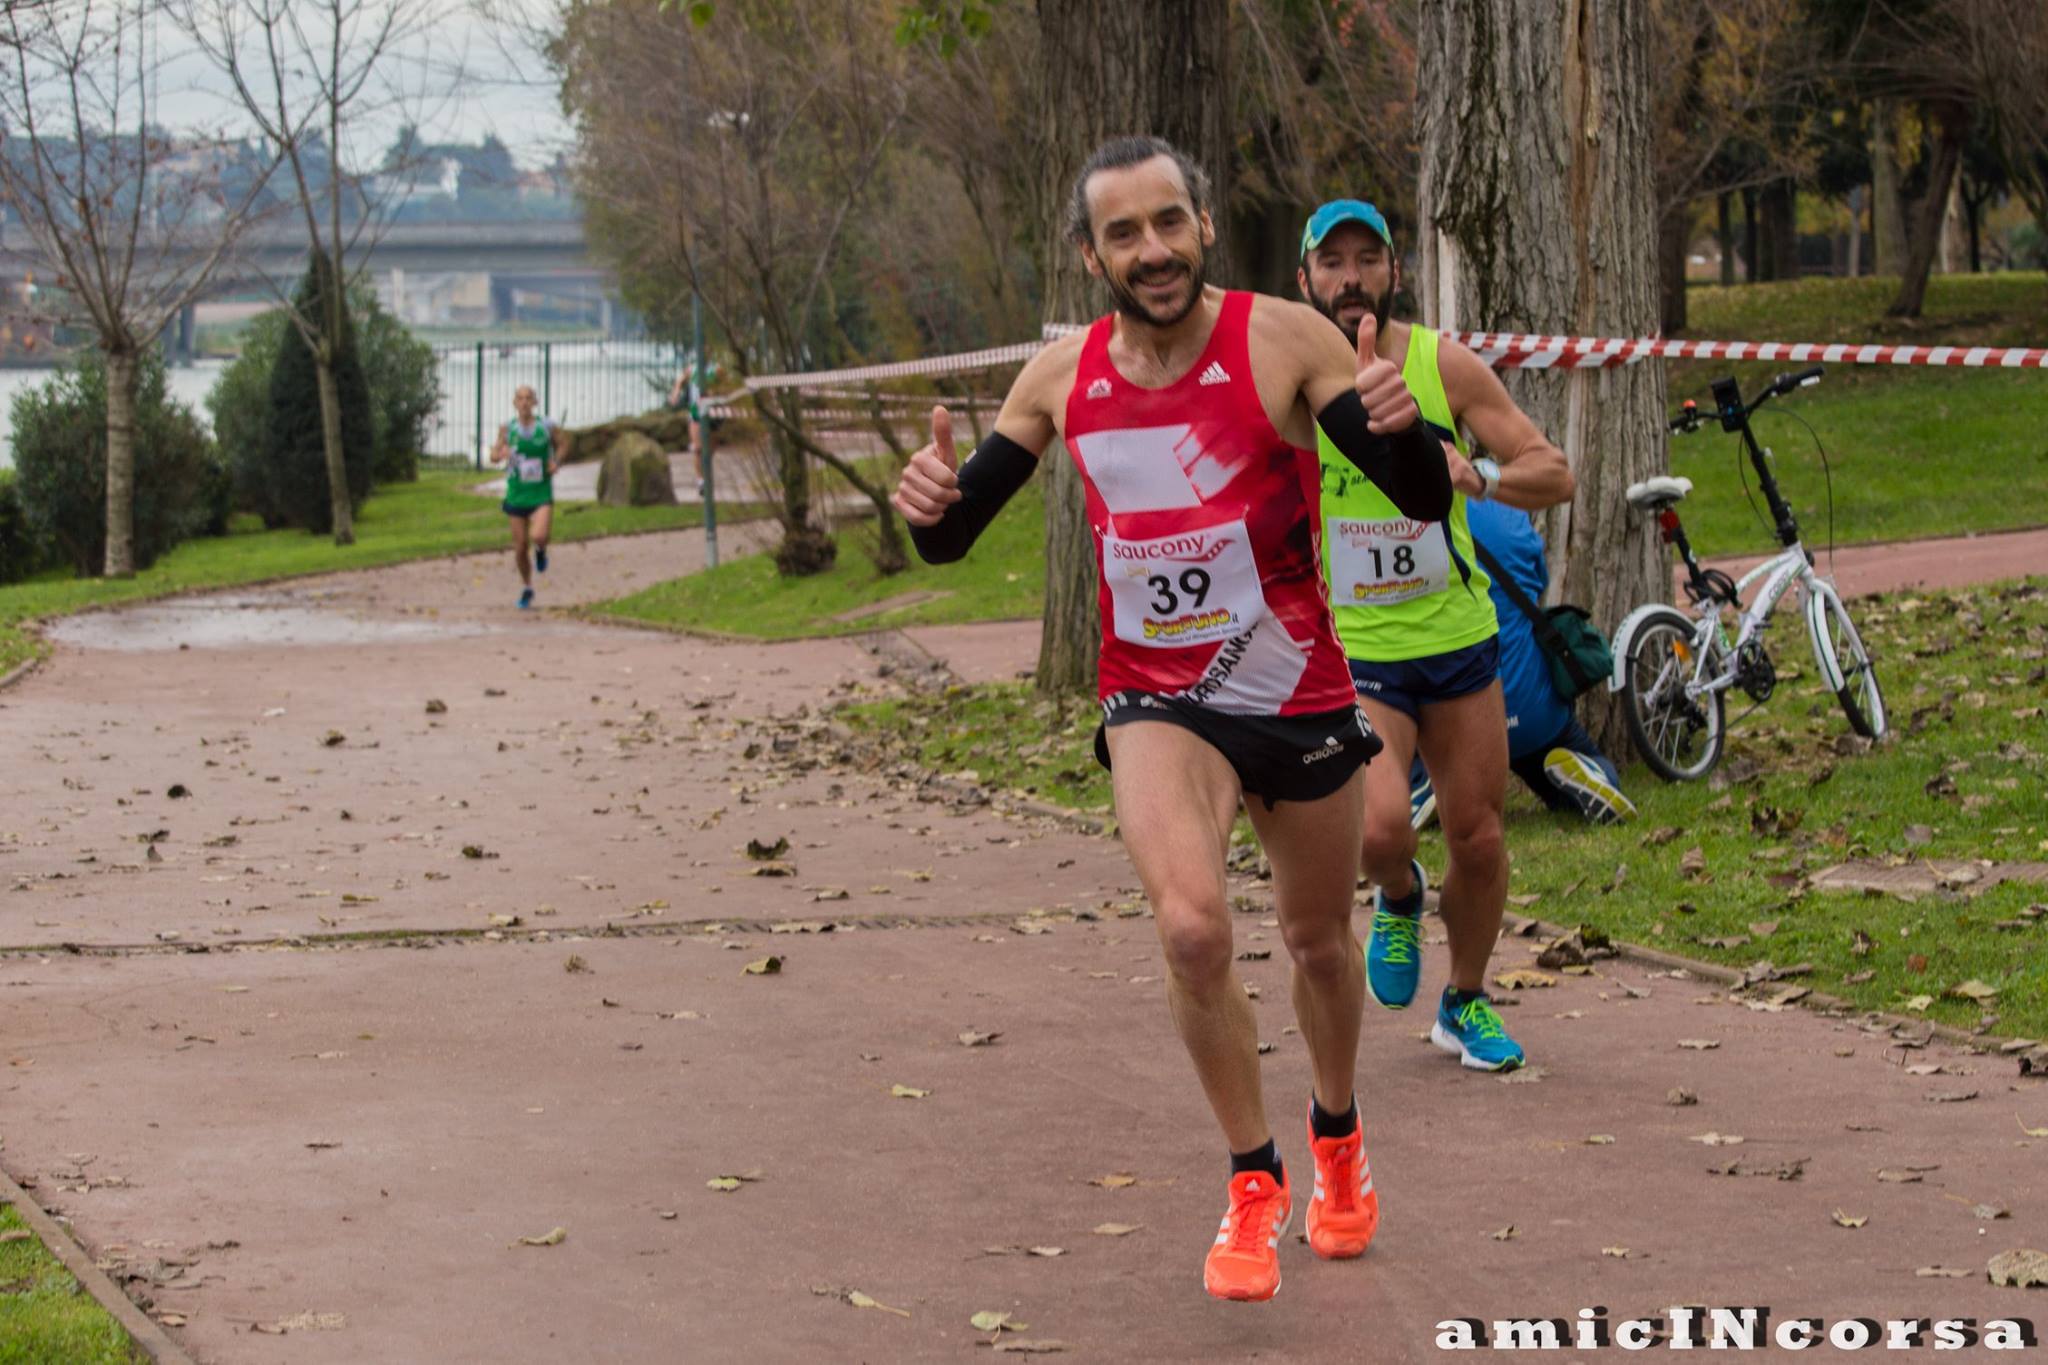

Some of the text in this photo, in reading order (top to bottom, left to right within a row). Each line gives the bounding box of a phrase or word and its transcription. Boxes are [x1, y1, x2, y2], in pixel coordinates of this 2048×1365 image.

[1339, 518, 1413, 538] saucony
[1113, 533, 1206, 560] saucony
[1368, 544, 1415, 579] 18
[1148, 567, 1211, 615] 39
